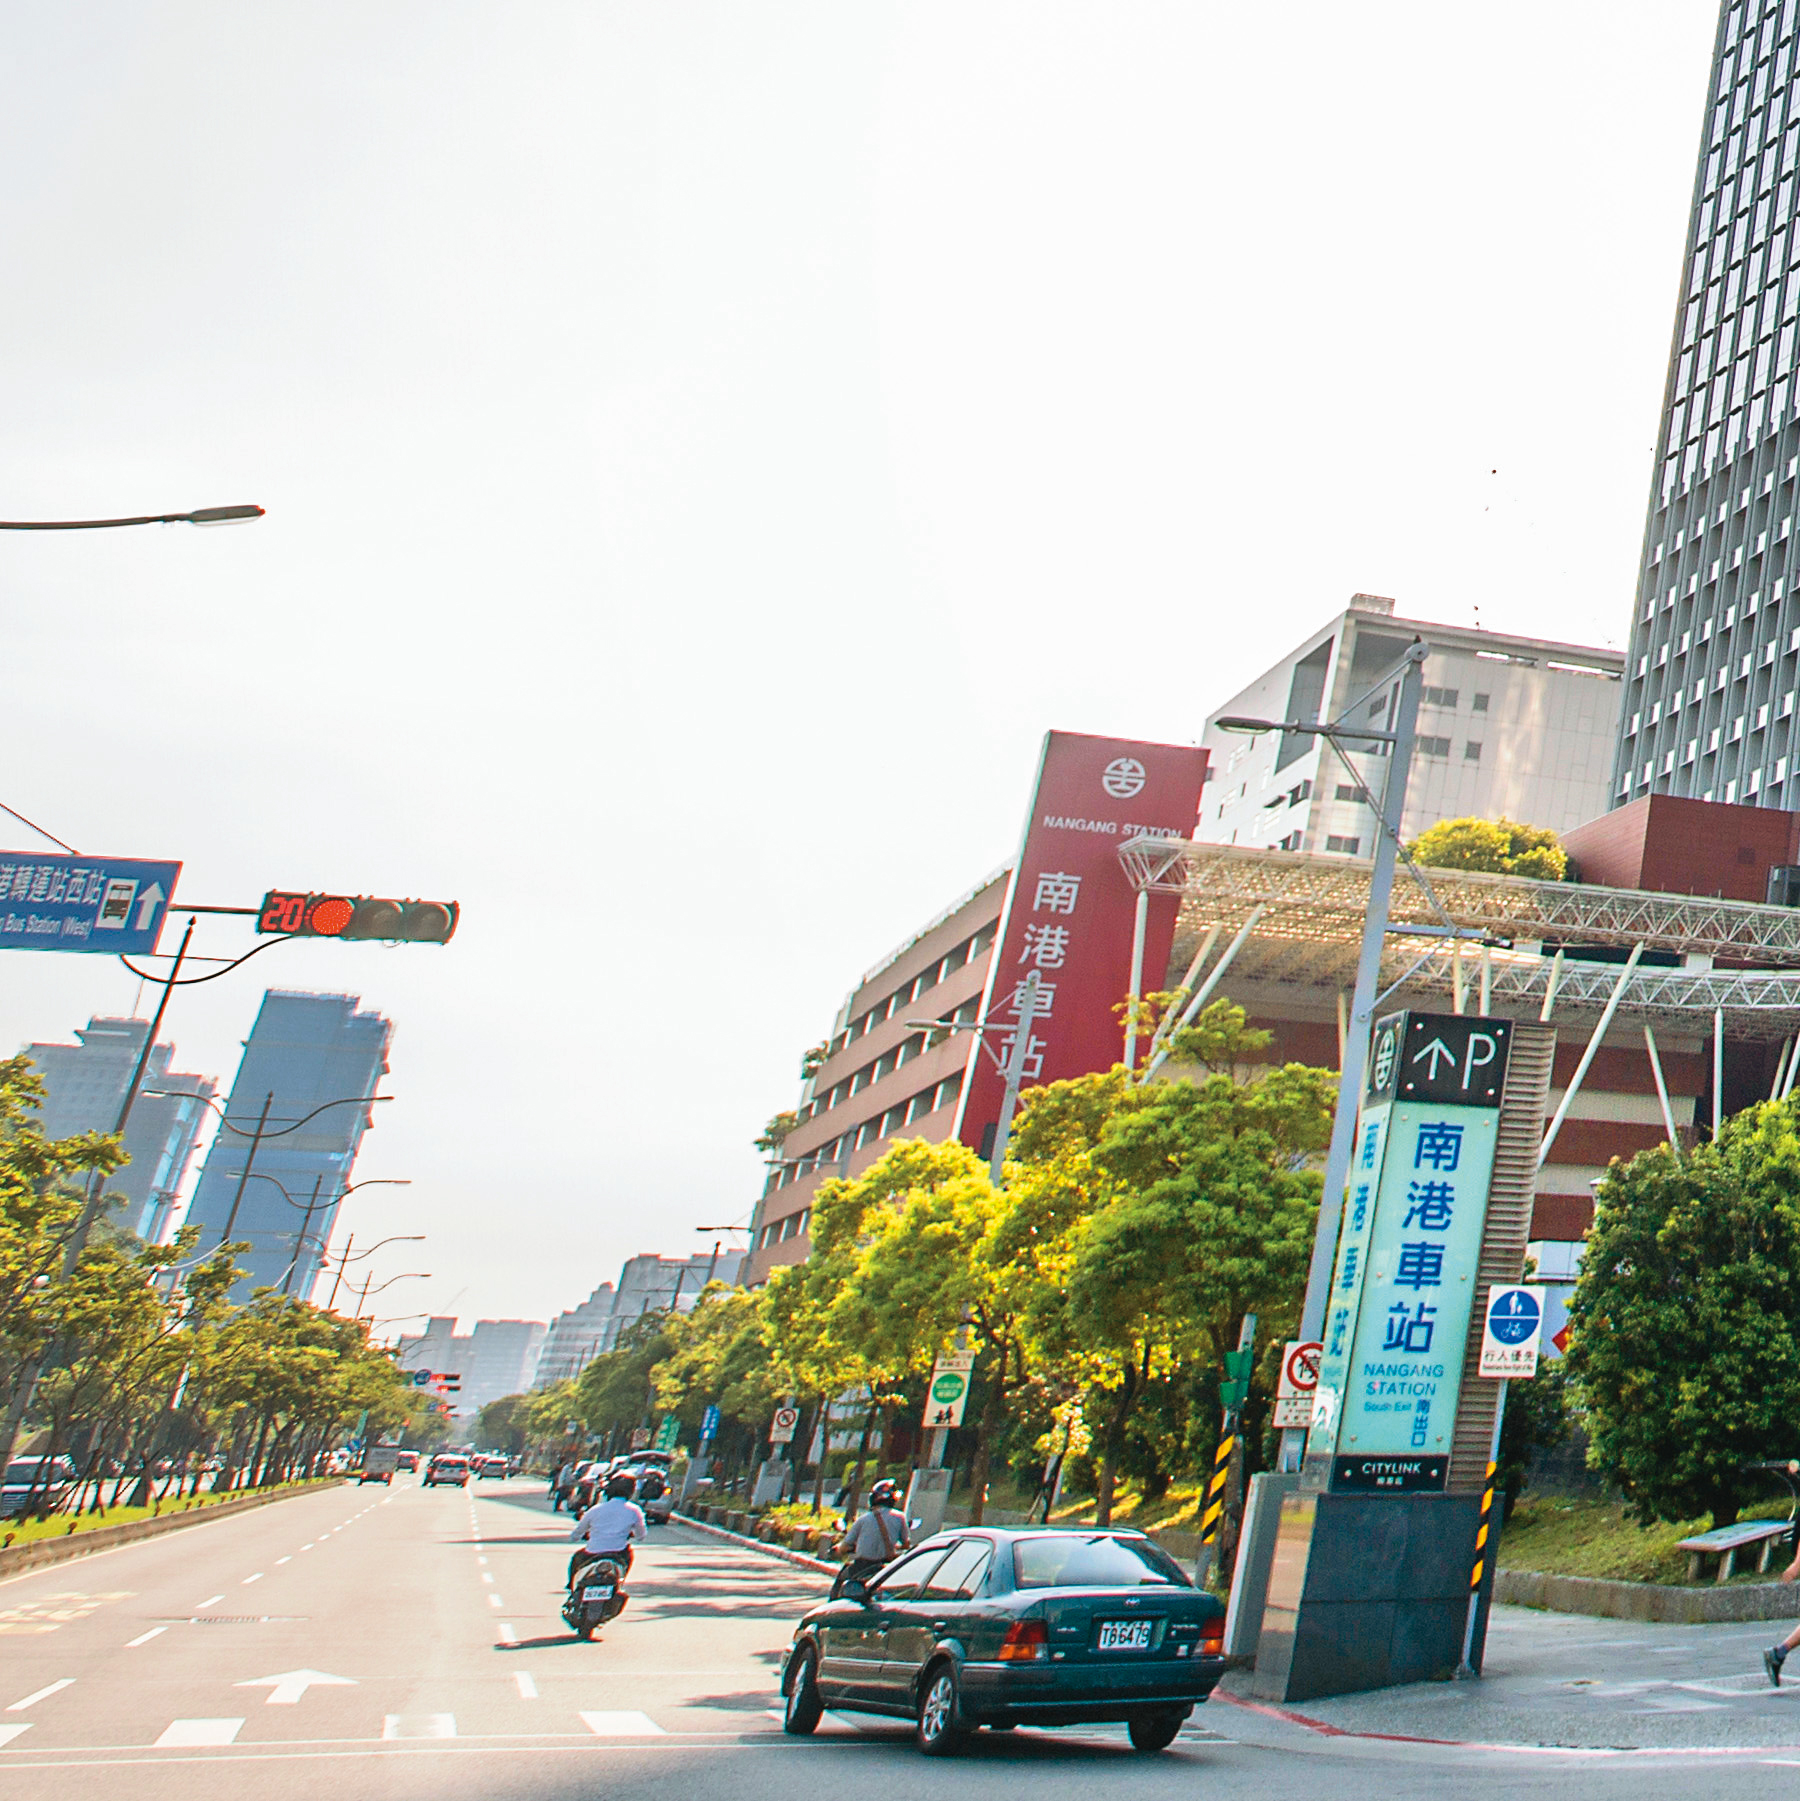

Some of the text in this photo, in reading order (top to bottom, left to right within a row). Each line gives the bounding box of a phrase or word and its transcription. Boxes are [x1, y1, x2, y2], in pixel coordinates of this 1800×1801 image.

[1043, 815, 1183, 839] NANGANG STATION
[4, 913, 26, 932] Bus
[25, 914, 62, 934] Station
[262, 897, 305, 931] 20
[1461, 1032, 1497, 1090] P
[1382, 1121, 1465, 1353] 南港車站
[1363, 1363, 1444, 1379] NANGANG
[1366, 1382, 1437, 1396] STATION
[1363, 1401, 1412, 1412] South Exit
[1362, 1462, 1422, 1475] CITYLINK
